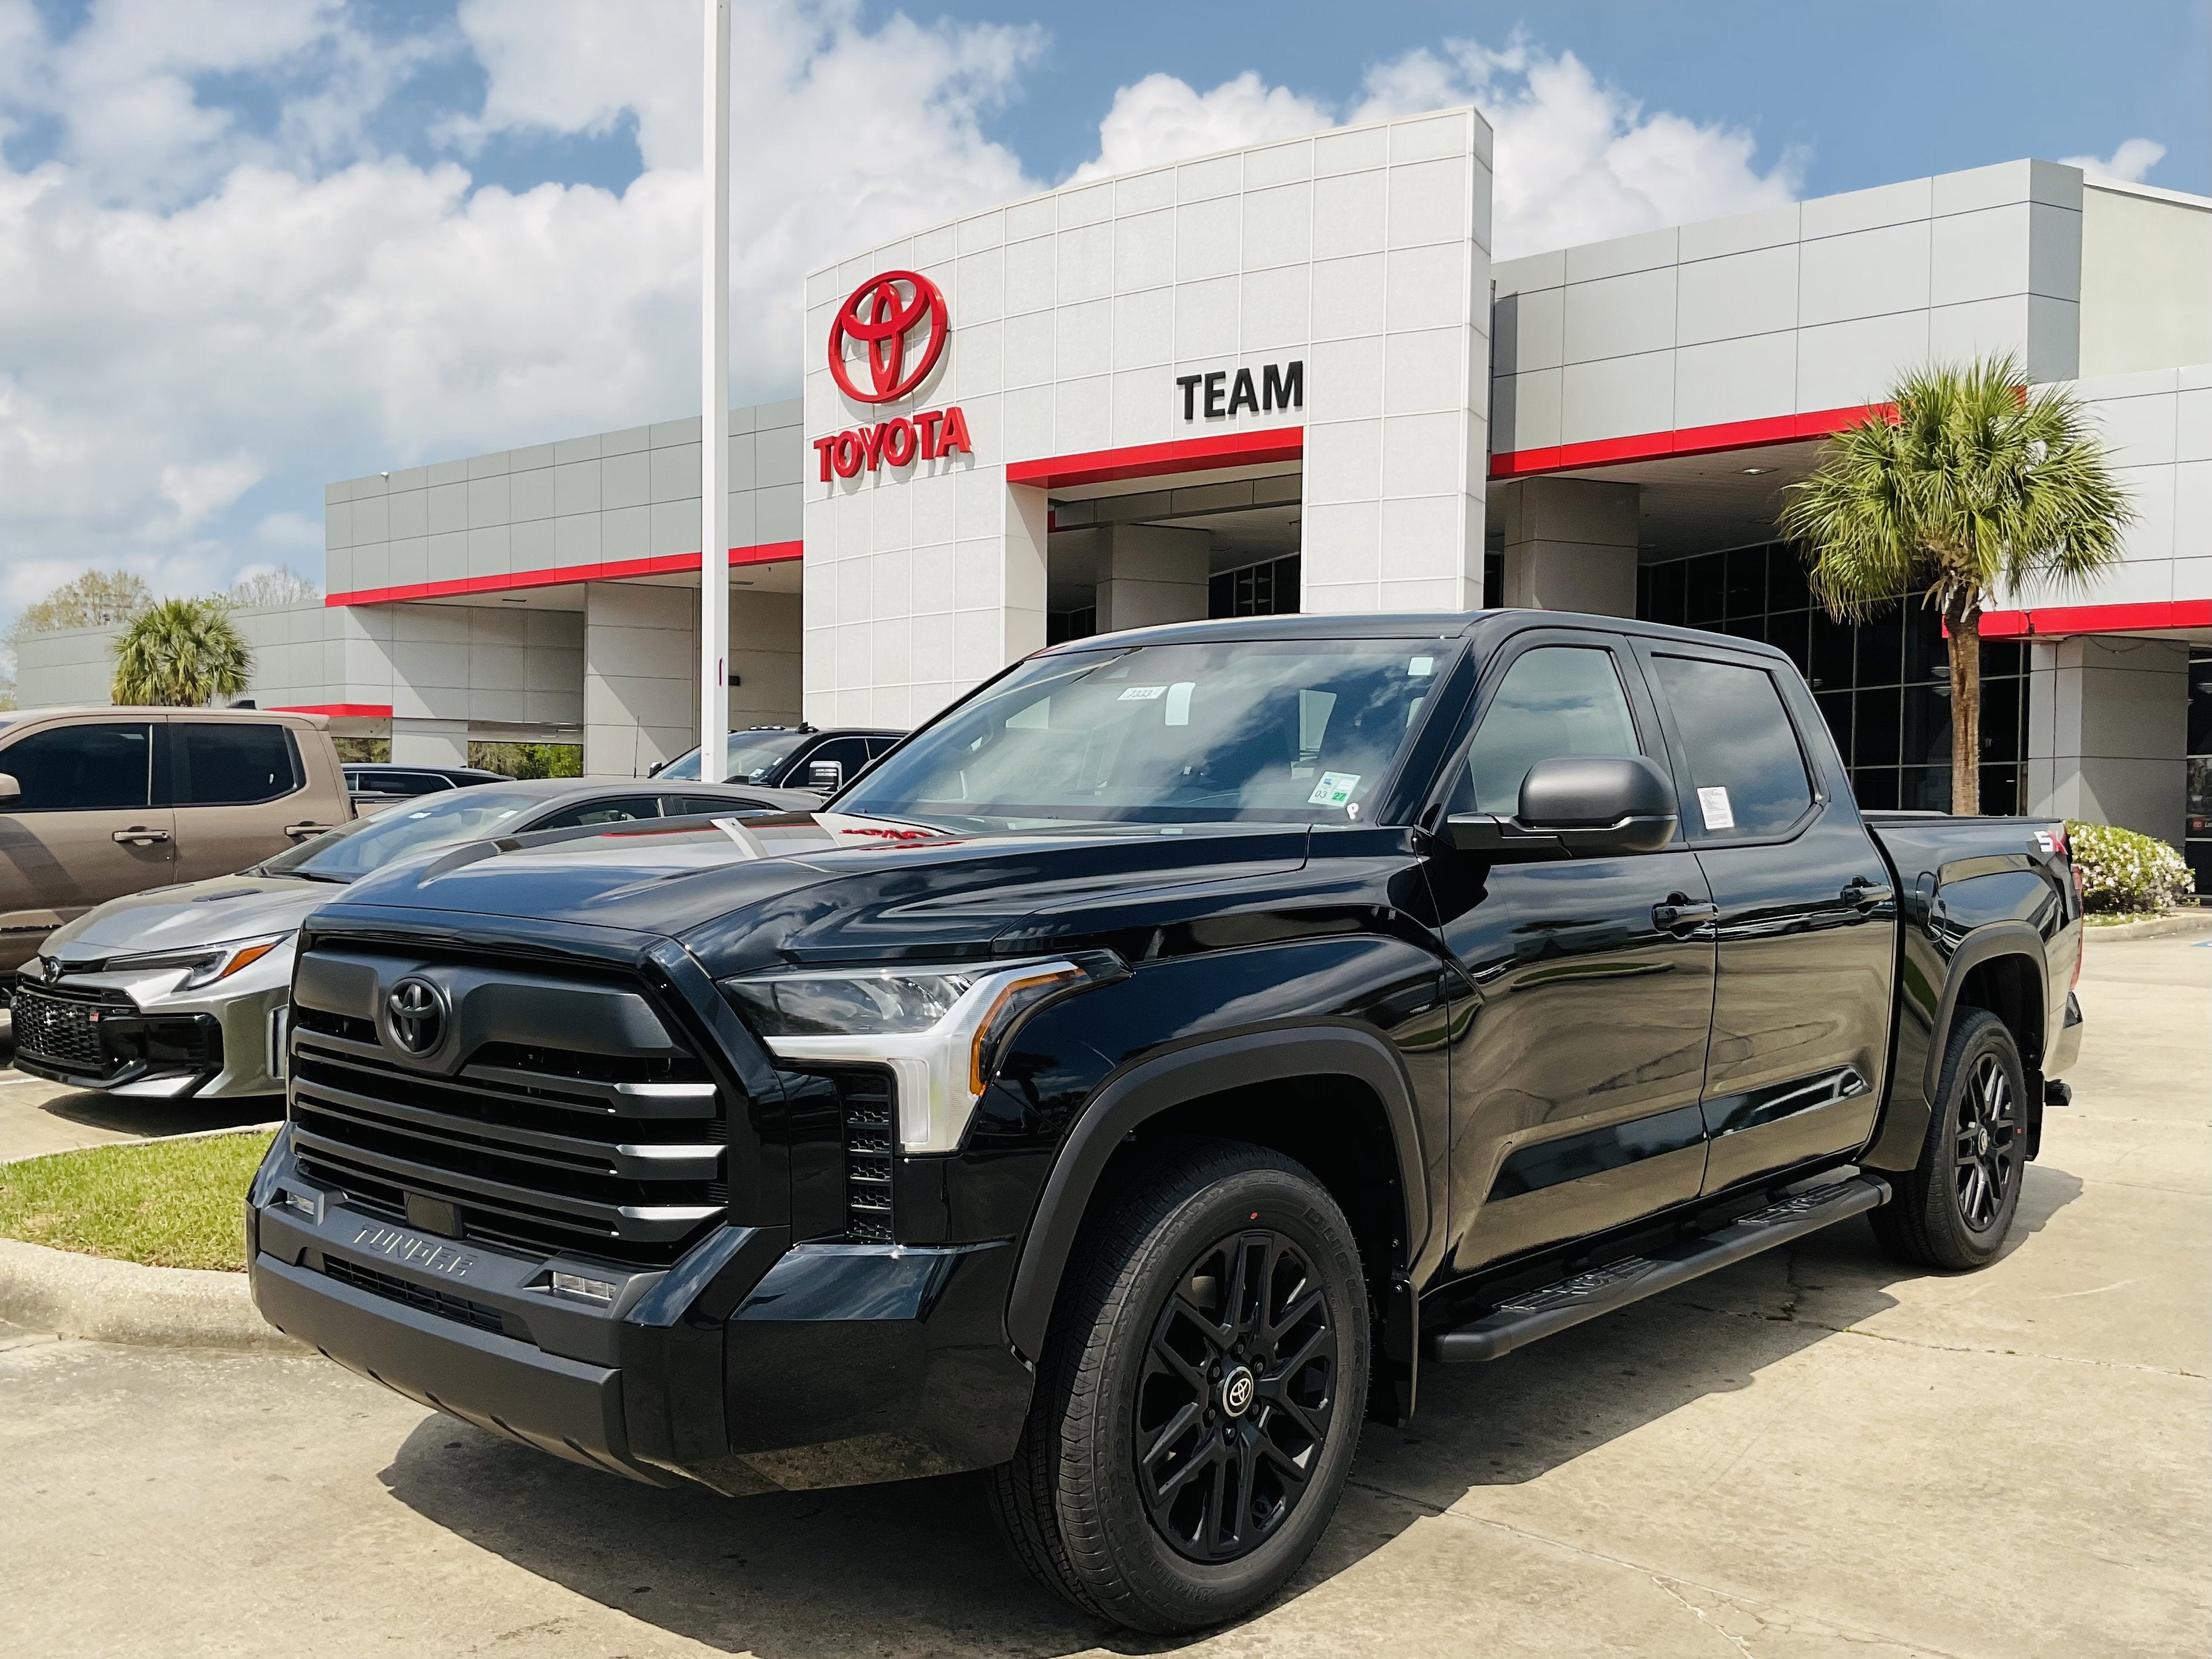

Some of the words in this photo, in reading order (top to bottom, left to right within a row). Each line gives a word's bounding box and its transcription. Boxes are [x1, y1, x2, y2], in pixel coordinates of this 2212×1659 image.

[1177, 361, 1303, 420] TEAM
[814, 407, 973, 482] TOYOTA
[1314, 790, 1327, 798] 03
[1333, 792, 1347, 801] 27
[353, 1222, 478, 1276] TUNDRA
